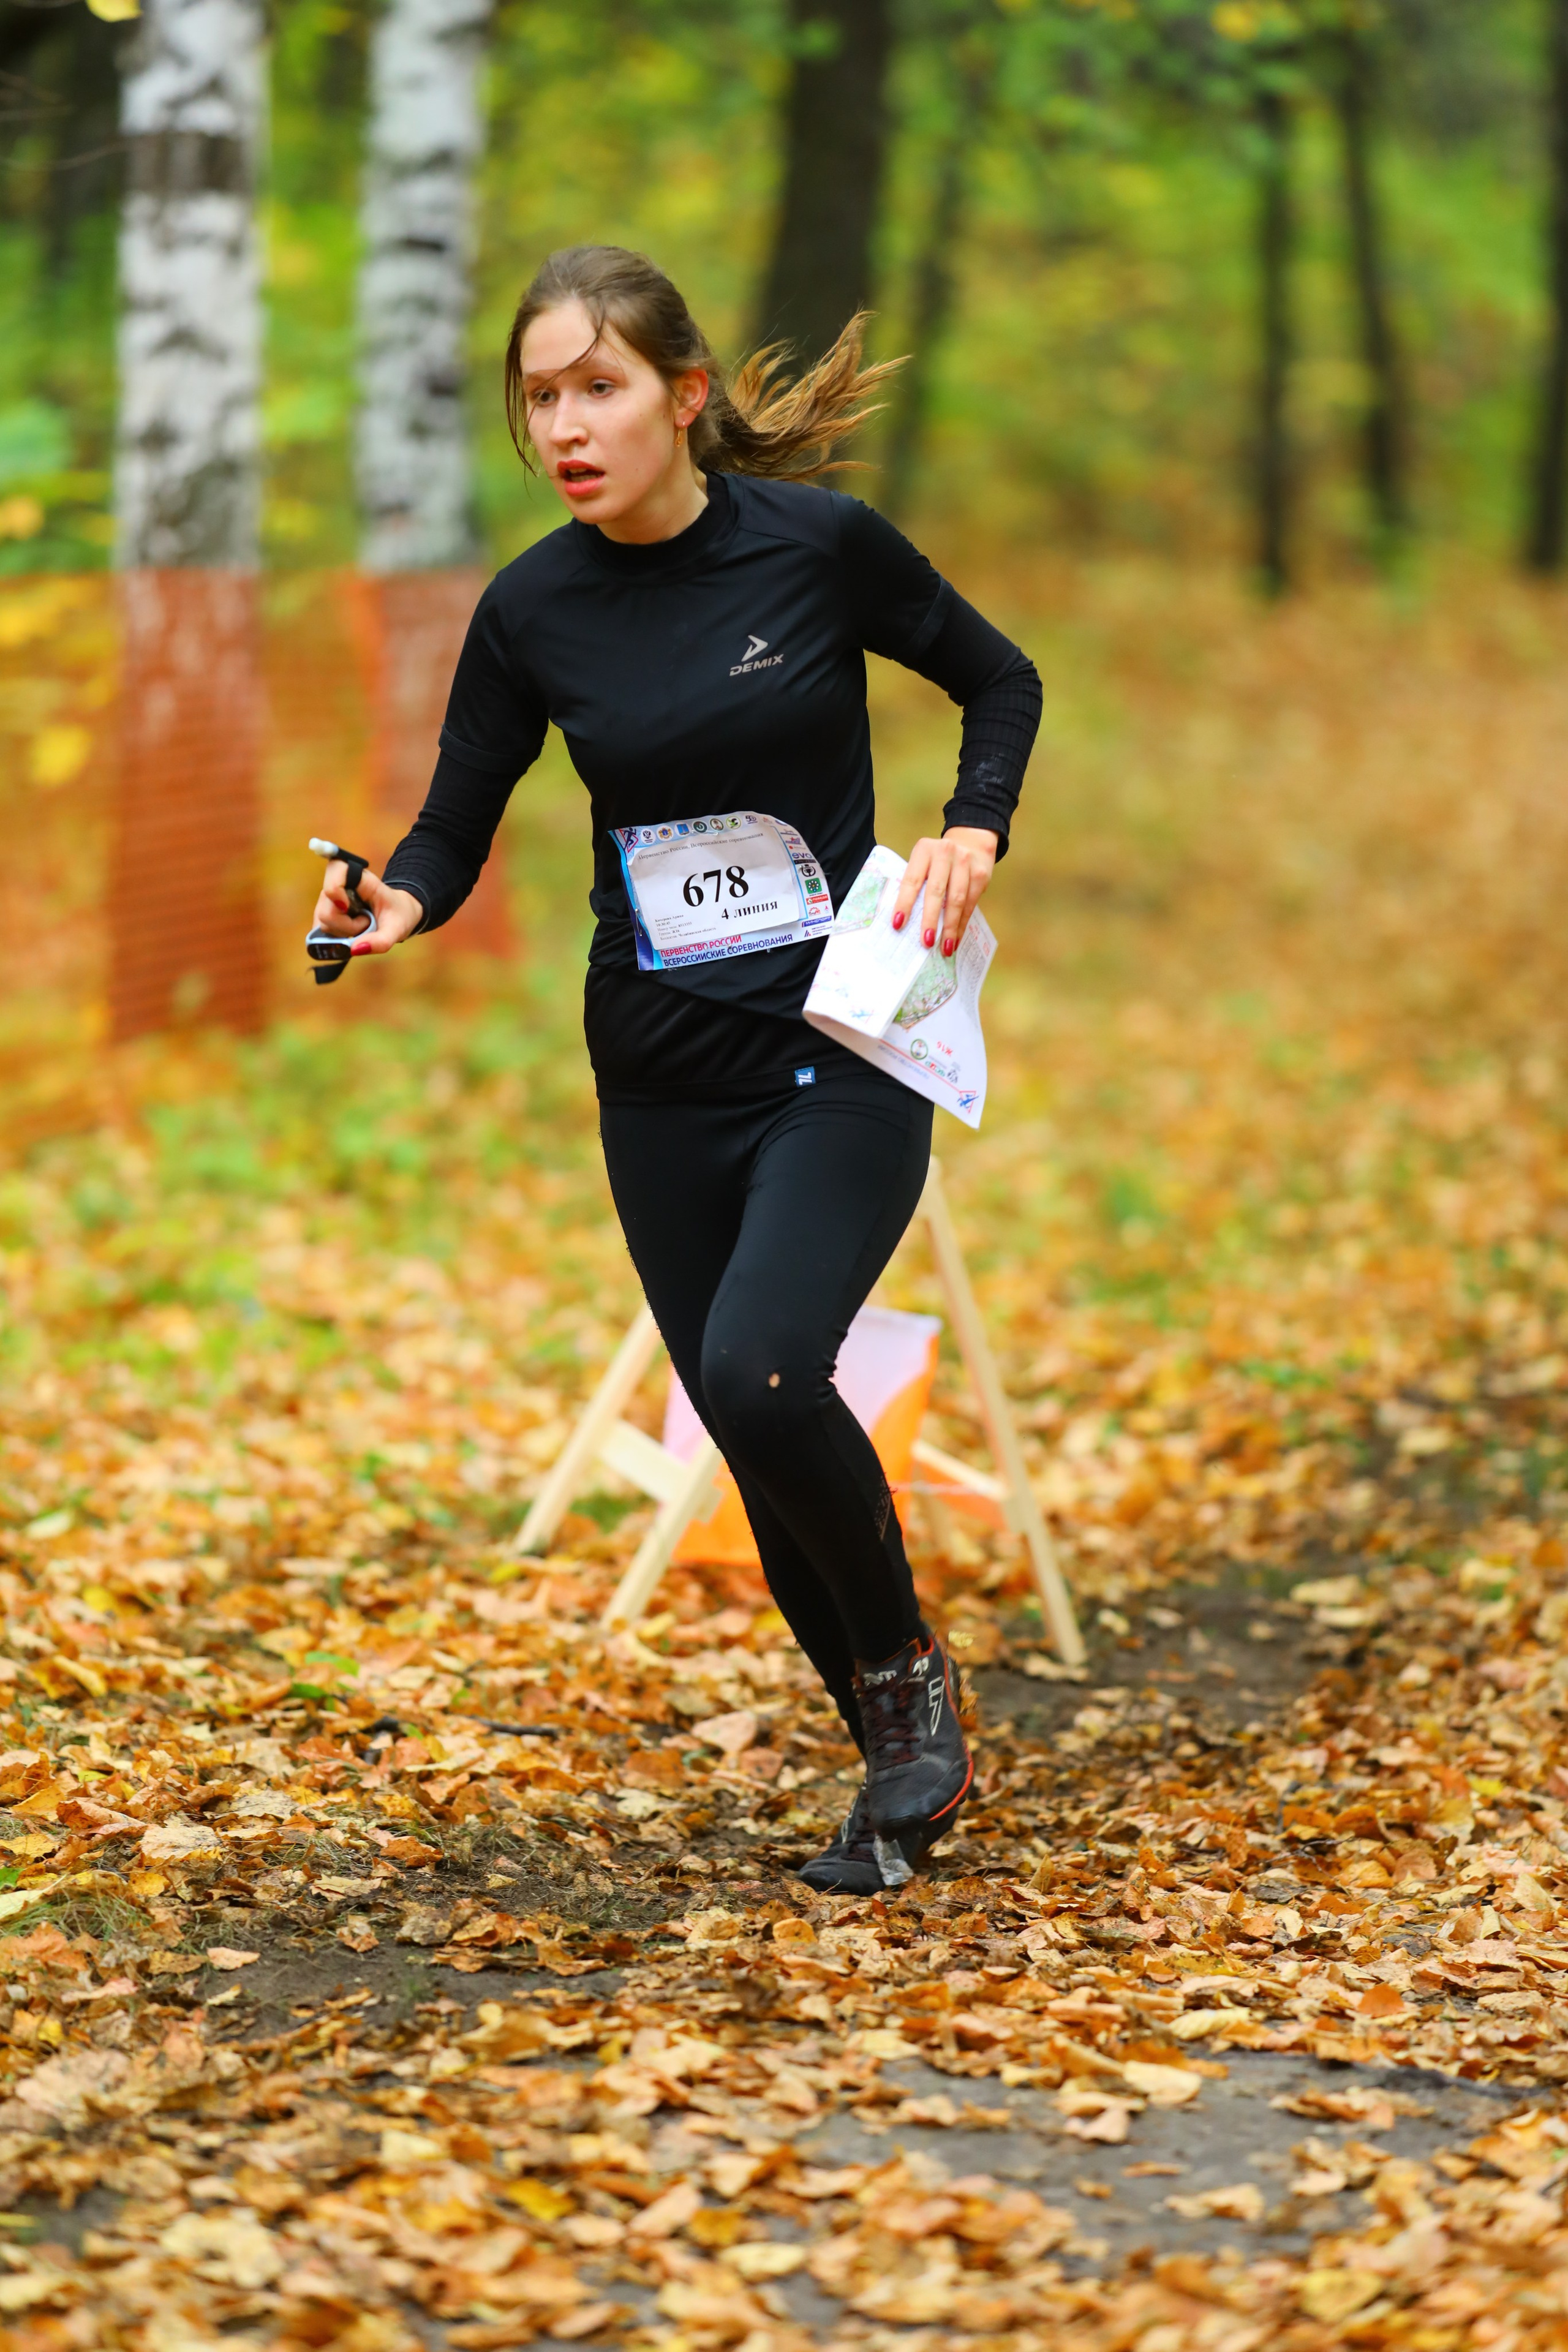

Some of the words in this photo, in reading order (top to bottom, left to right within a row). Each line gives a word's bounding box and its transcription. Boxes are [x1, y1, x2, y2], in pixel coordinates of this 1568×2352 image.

[729, 654, 784, 676] DEMIX
[683, 865, 749, 907] 678
[722, 908, 729, 919] 4
[661, 942, 709, 957] ПЕРВЕНСТВО
[709, 935, 742, 949] РОССИИ
[727, 934, 793, 956] СОРЕВНОВАНИЯ
